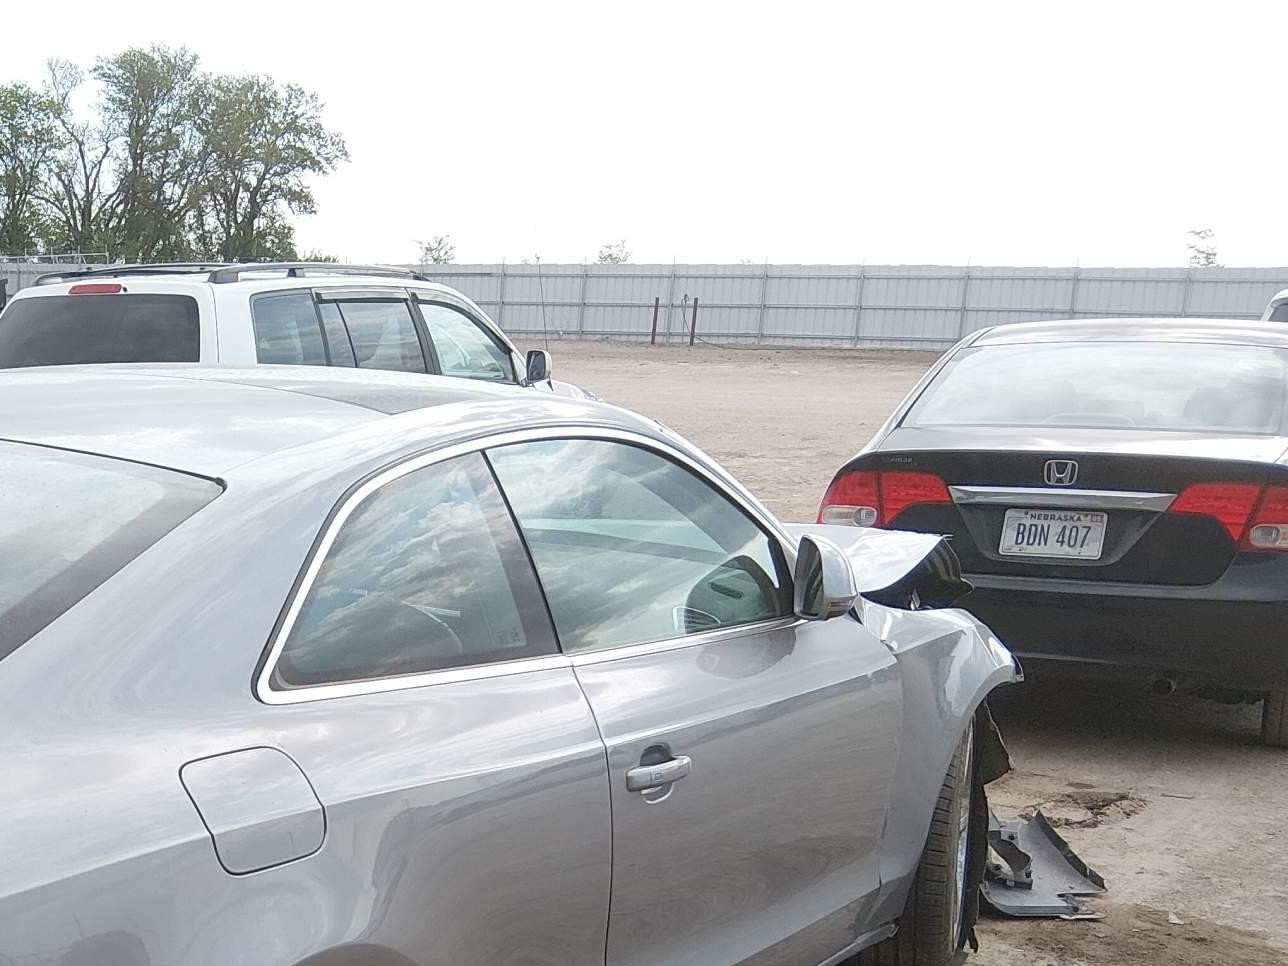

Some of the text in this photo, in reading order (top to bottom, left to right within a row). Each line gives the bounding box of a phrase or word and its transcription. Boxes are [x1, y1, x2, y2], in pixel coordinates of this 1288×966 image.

[1030, 513, 1082, 522] NEBRASKA
[1014, 522, 1092, 549] BDN 407
